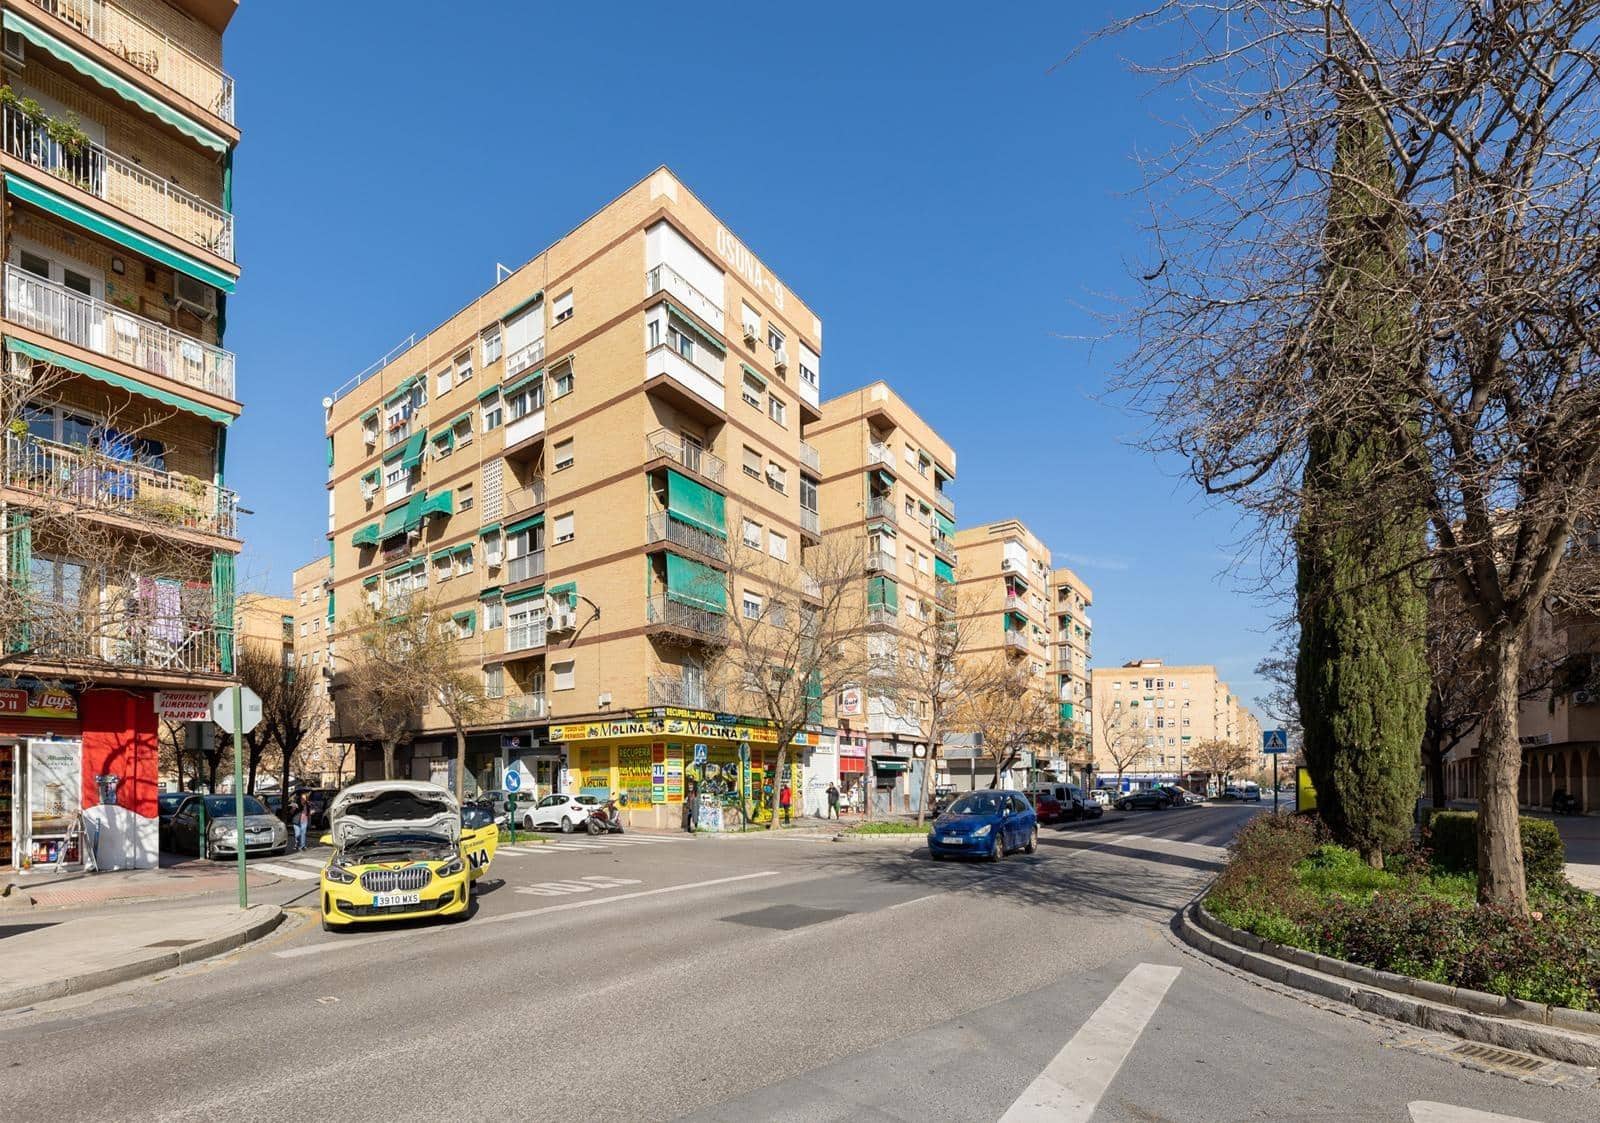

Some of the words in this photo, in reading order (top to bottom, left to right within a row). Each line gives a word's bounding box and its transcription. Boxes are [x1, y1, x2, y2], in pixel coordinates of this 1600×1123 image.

[163, 711, 206, 719] FAJARDO
[599, 723, 645, 736] MOLINA
[687, 720, 737, 738] MOLINA
[379, 895, 400, 905] 3910
